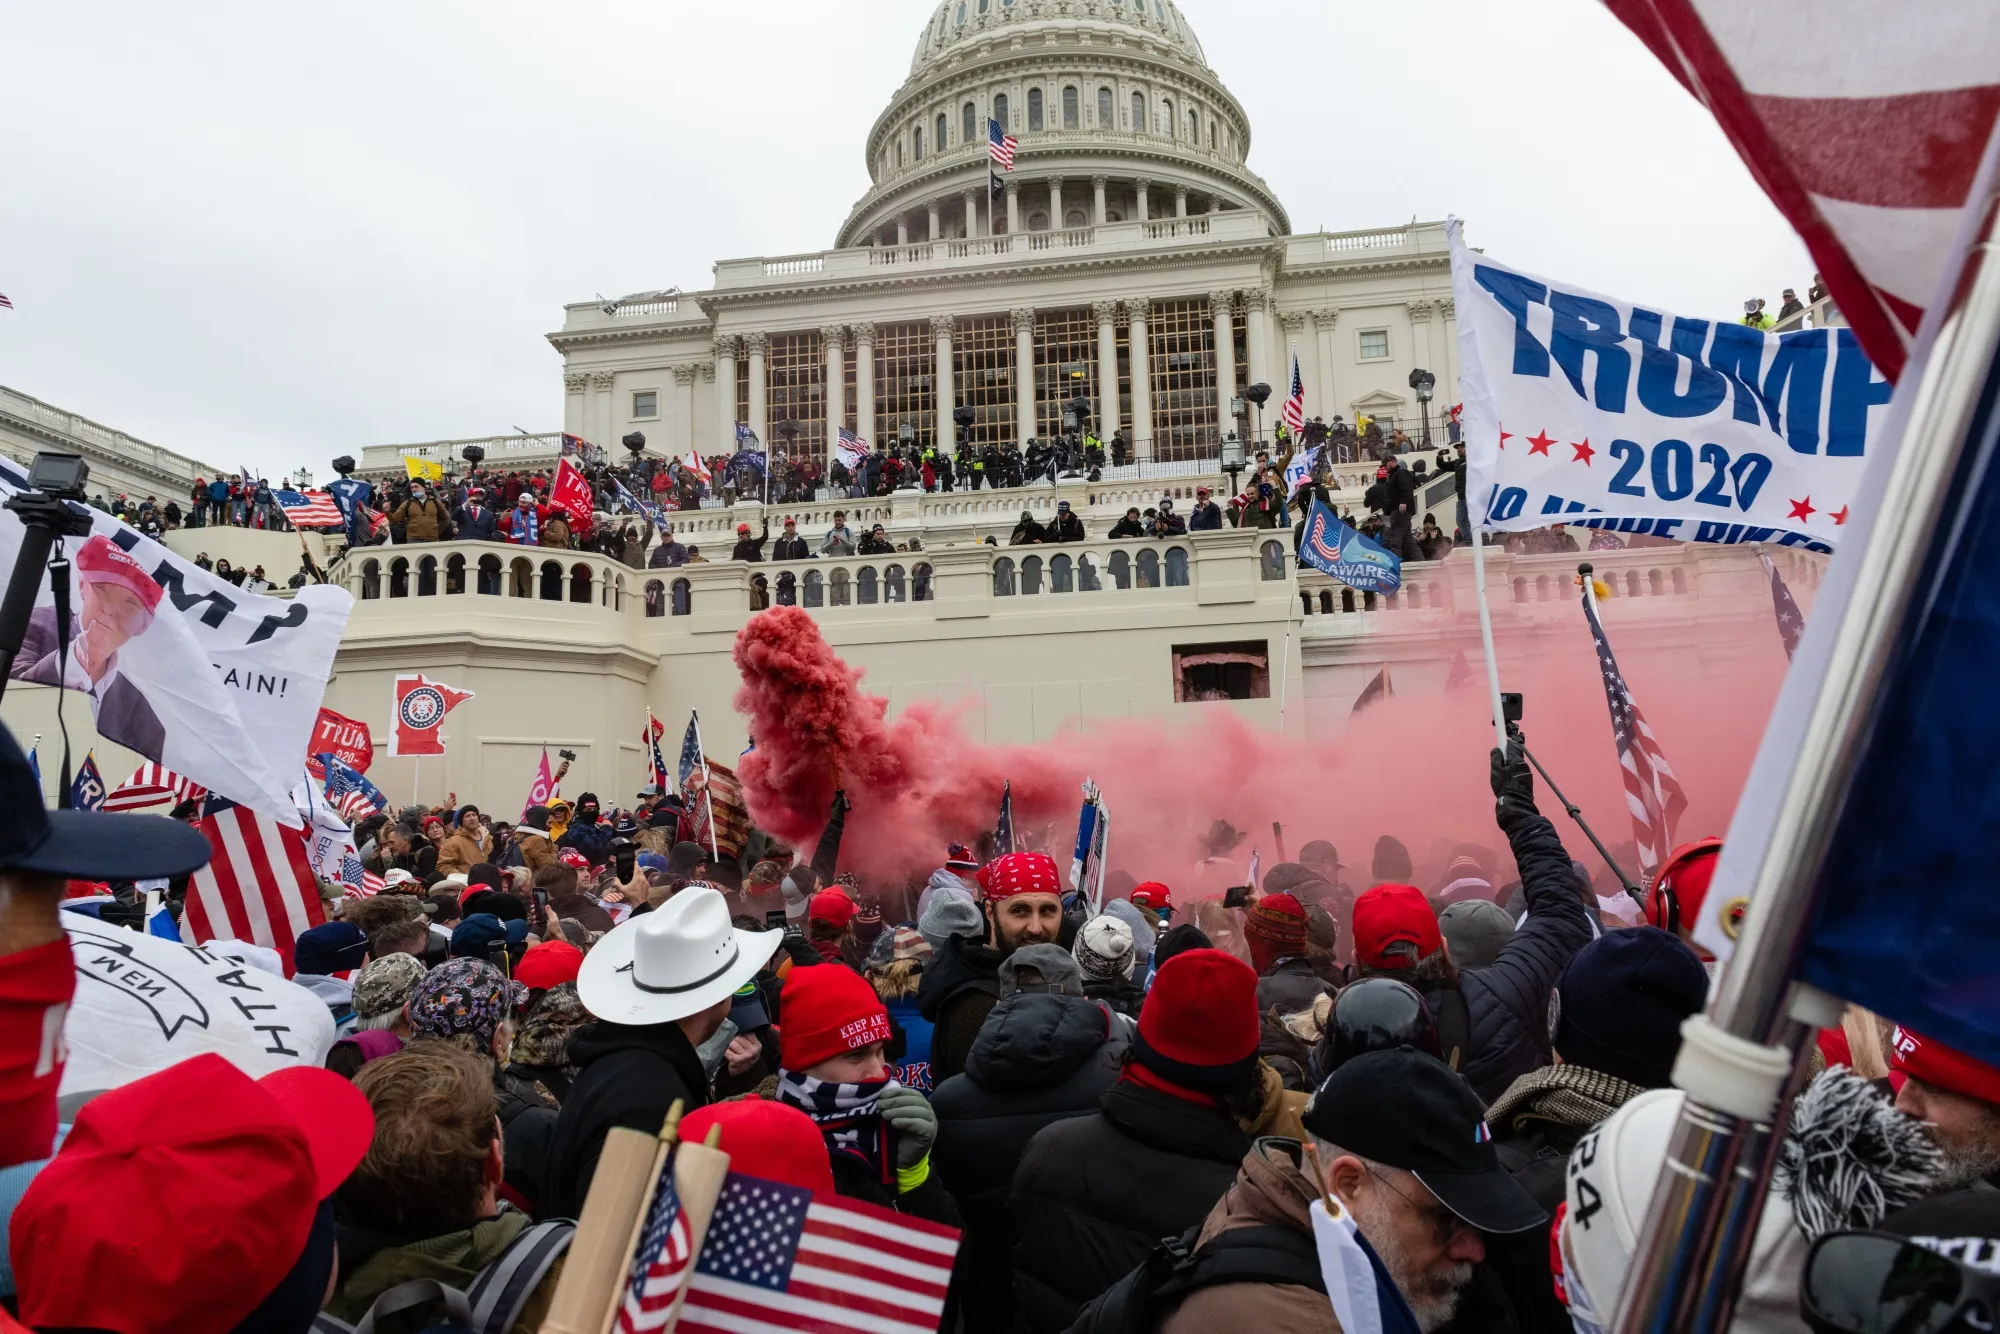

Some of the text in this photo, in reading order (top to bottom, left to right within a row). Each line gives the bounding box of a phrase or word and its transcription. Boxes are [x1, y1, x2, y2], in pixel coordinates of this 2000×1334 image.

[1474, 264, 1893, 457] TRUMP
[1608, 439, 1773, 513] 2020
[840, 1018, 868, 1039] KEEP
[848, 1027, 881, 1048] GREAT
